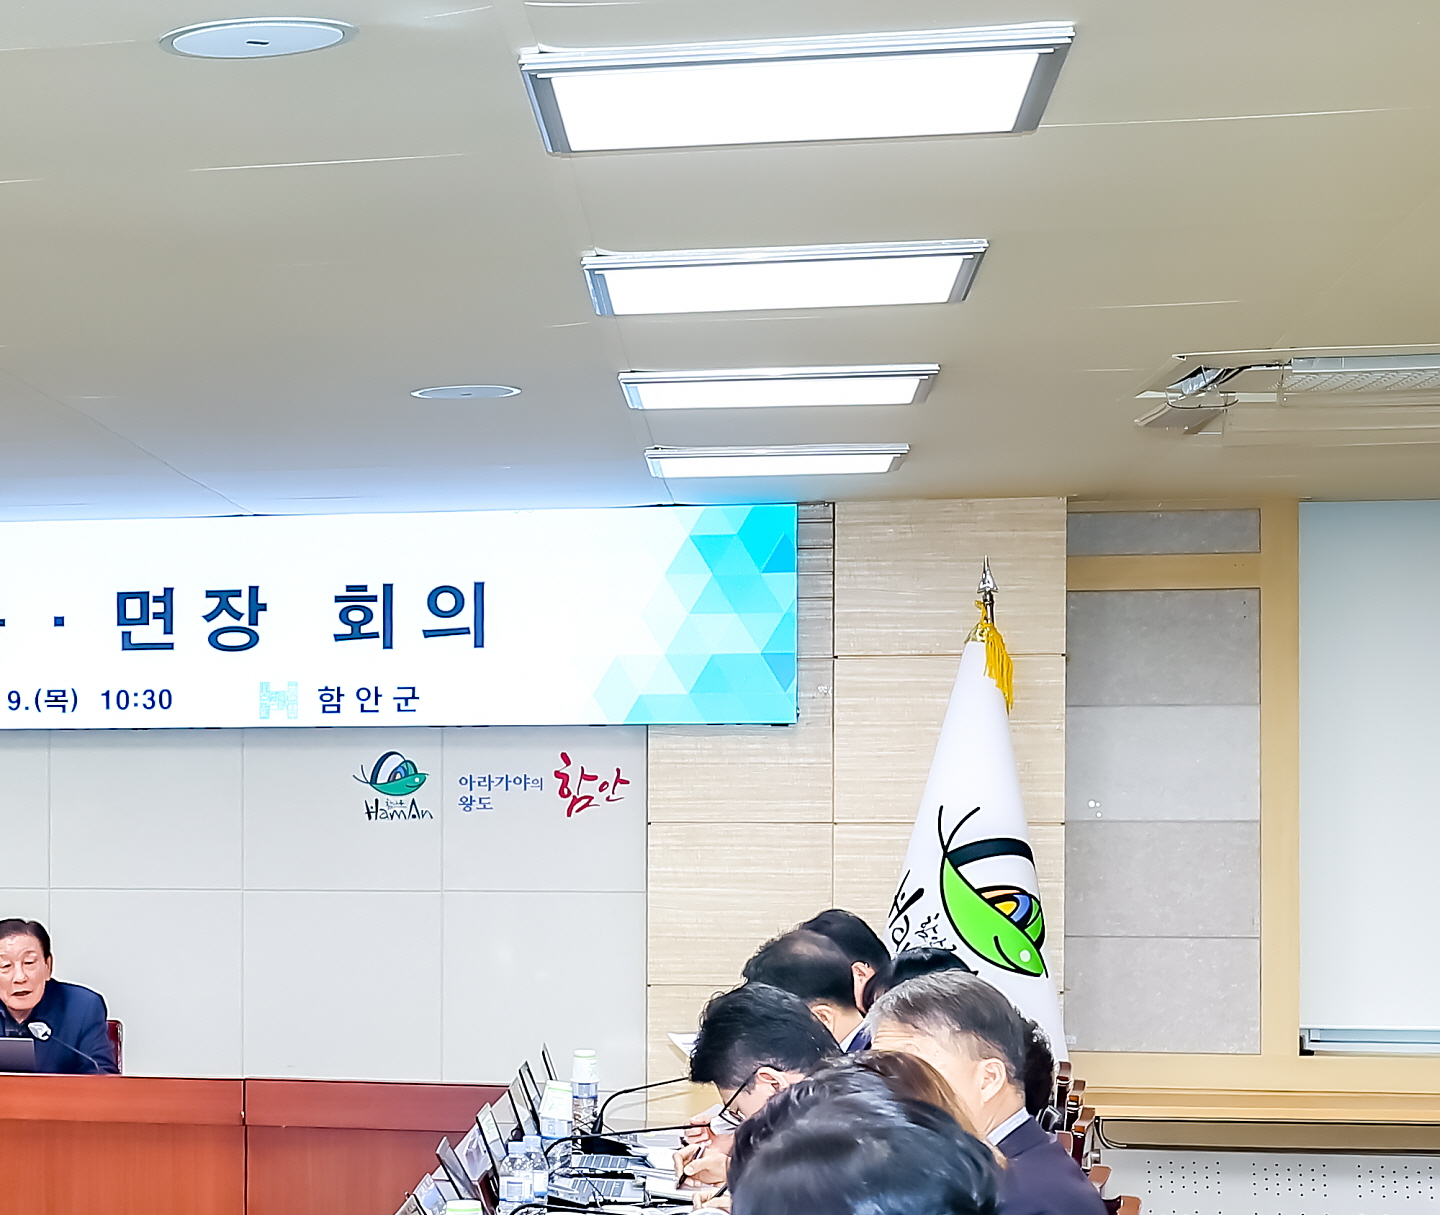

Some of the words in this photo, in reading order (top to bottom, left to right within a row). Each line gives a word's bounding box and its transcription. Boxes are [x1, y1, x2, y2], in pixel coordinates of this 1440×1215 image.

[116, 585, 267, 652] 면장
[333, 581, 485, 650] 회의
[7, 688, 78, 713] 9.(목)
[101, 689, 172, 711] 10:30
[318, 686, 420, 714] 함안군
[458, 773, 543, 792] 아라가야의
[553, 751, 631, 818] 함안
[364, 797, 434, 822] HamAn
[458, 795, 494, 812] 왕도
